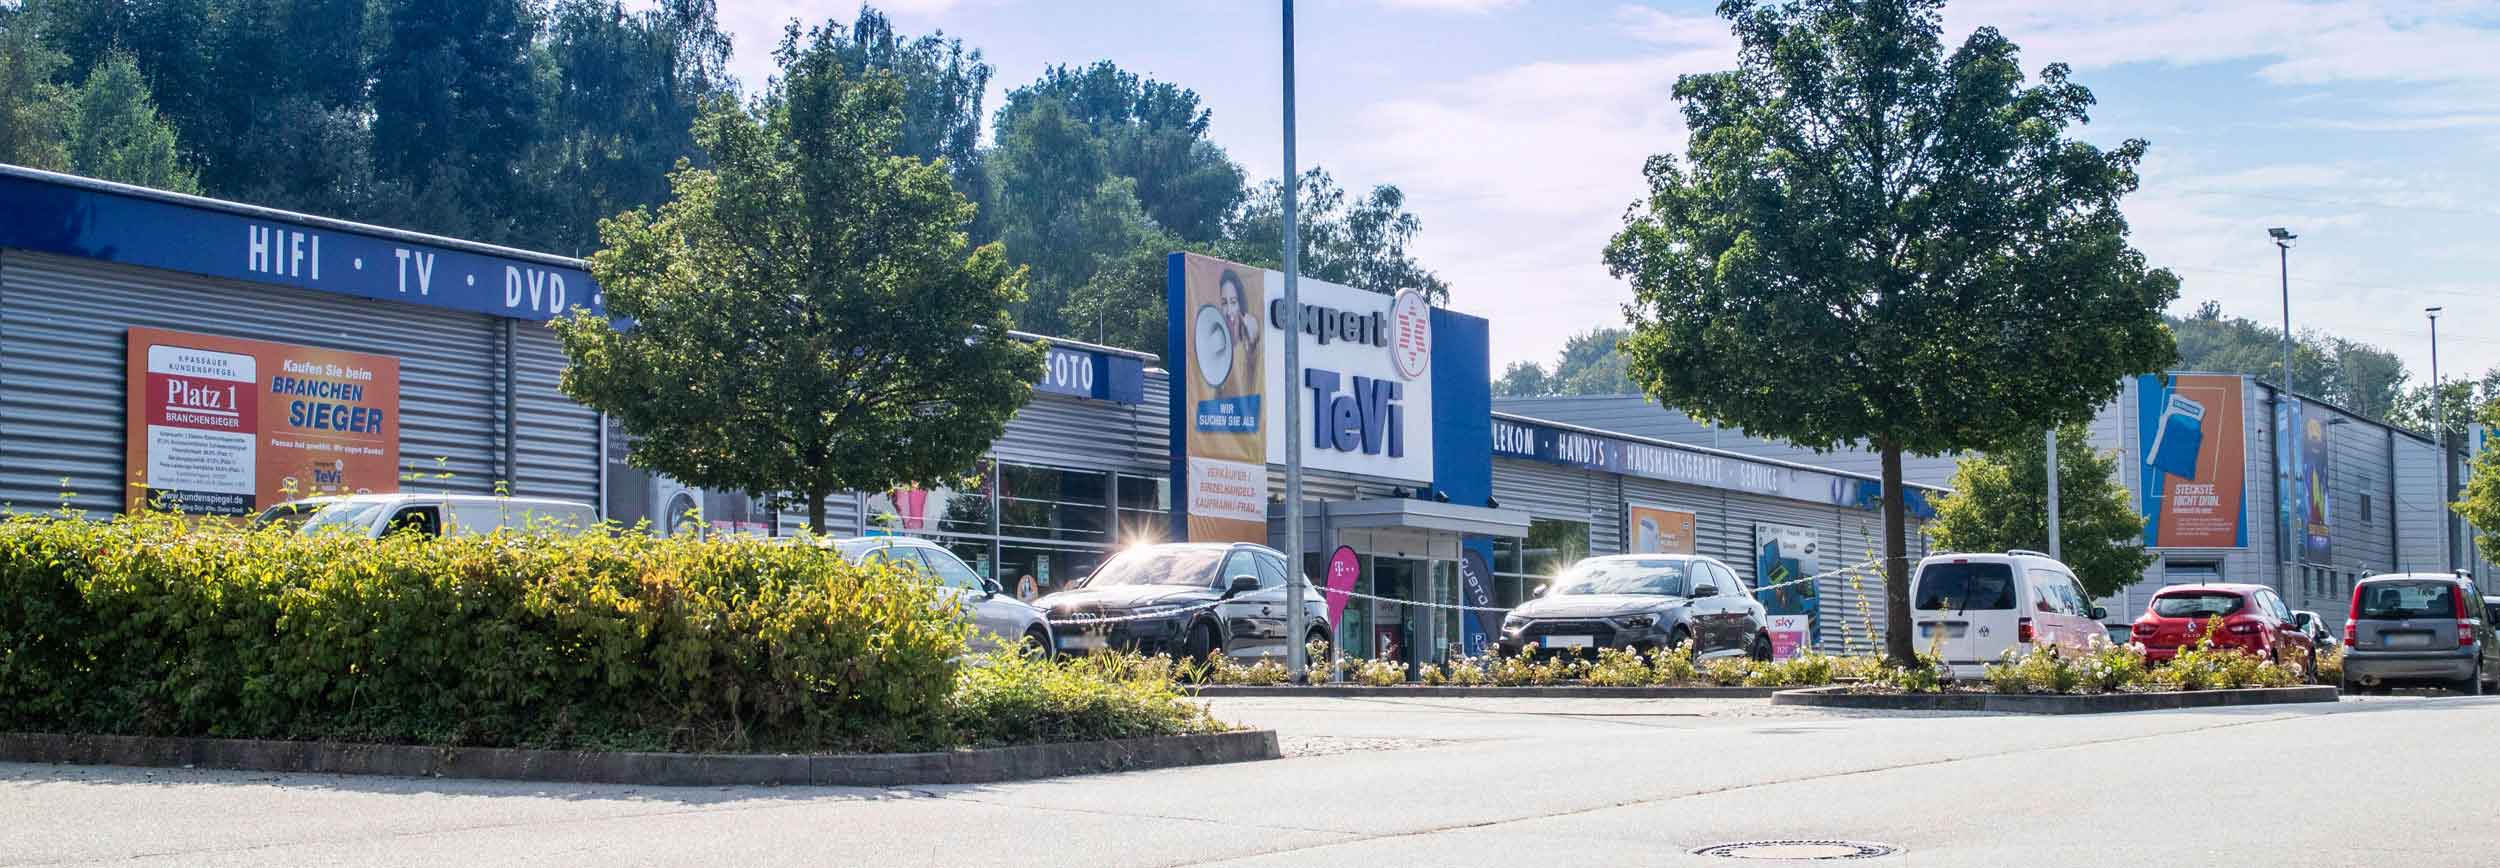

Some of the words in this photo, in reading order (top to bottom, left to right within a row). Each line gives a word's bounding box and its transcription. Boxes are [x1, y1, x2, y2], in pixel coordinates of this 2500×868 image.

[249, 224, 319, 280] HIFI
[395, 248, 434, 295] TV
[505, 265, 566, 314] DVD
[169, 363, 236, 377] KUNDENSPIEGEL
[283, 359, 323, 375] Kaufen
[325, 364, 343, 377] Sie
[345, 366, 373, 380] beim
[1045, 352, 1093, 390] FOTO
[167, 379, 221, 408] Platz
[227, 384, 237, 409] 1
[271, 376, 363, 401] BRANCHEN
[166, 412, 240, 427] BRANCHENSIEGER
[288, 399, 384, 433] SIEGER
[1199, 414, 1227, 426] SUCHEN
[1228, 415, 1241, 427] SIE
[1220, 403, 1234, 415] WIR
[1305, 368, 1404, 458] TeVi
[1493, 423, 1534, 456] LEKOM
[1559, 433, 1605, 466] HANDYS
[1740, 463, 1777, 492] SERVICE
[314, 469, 342, 484] TeVi
[1775, 616, 1794, 629] sky
